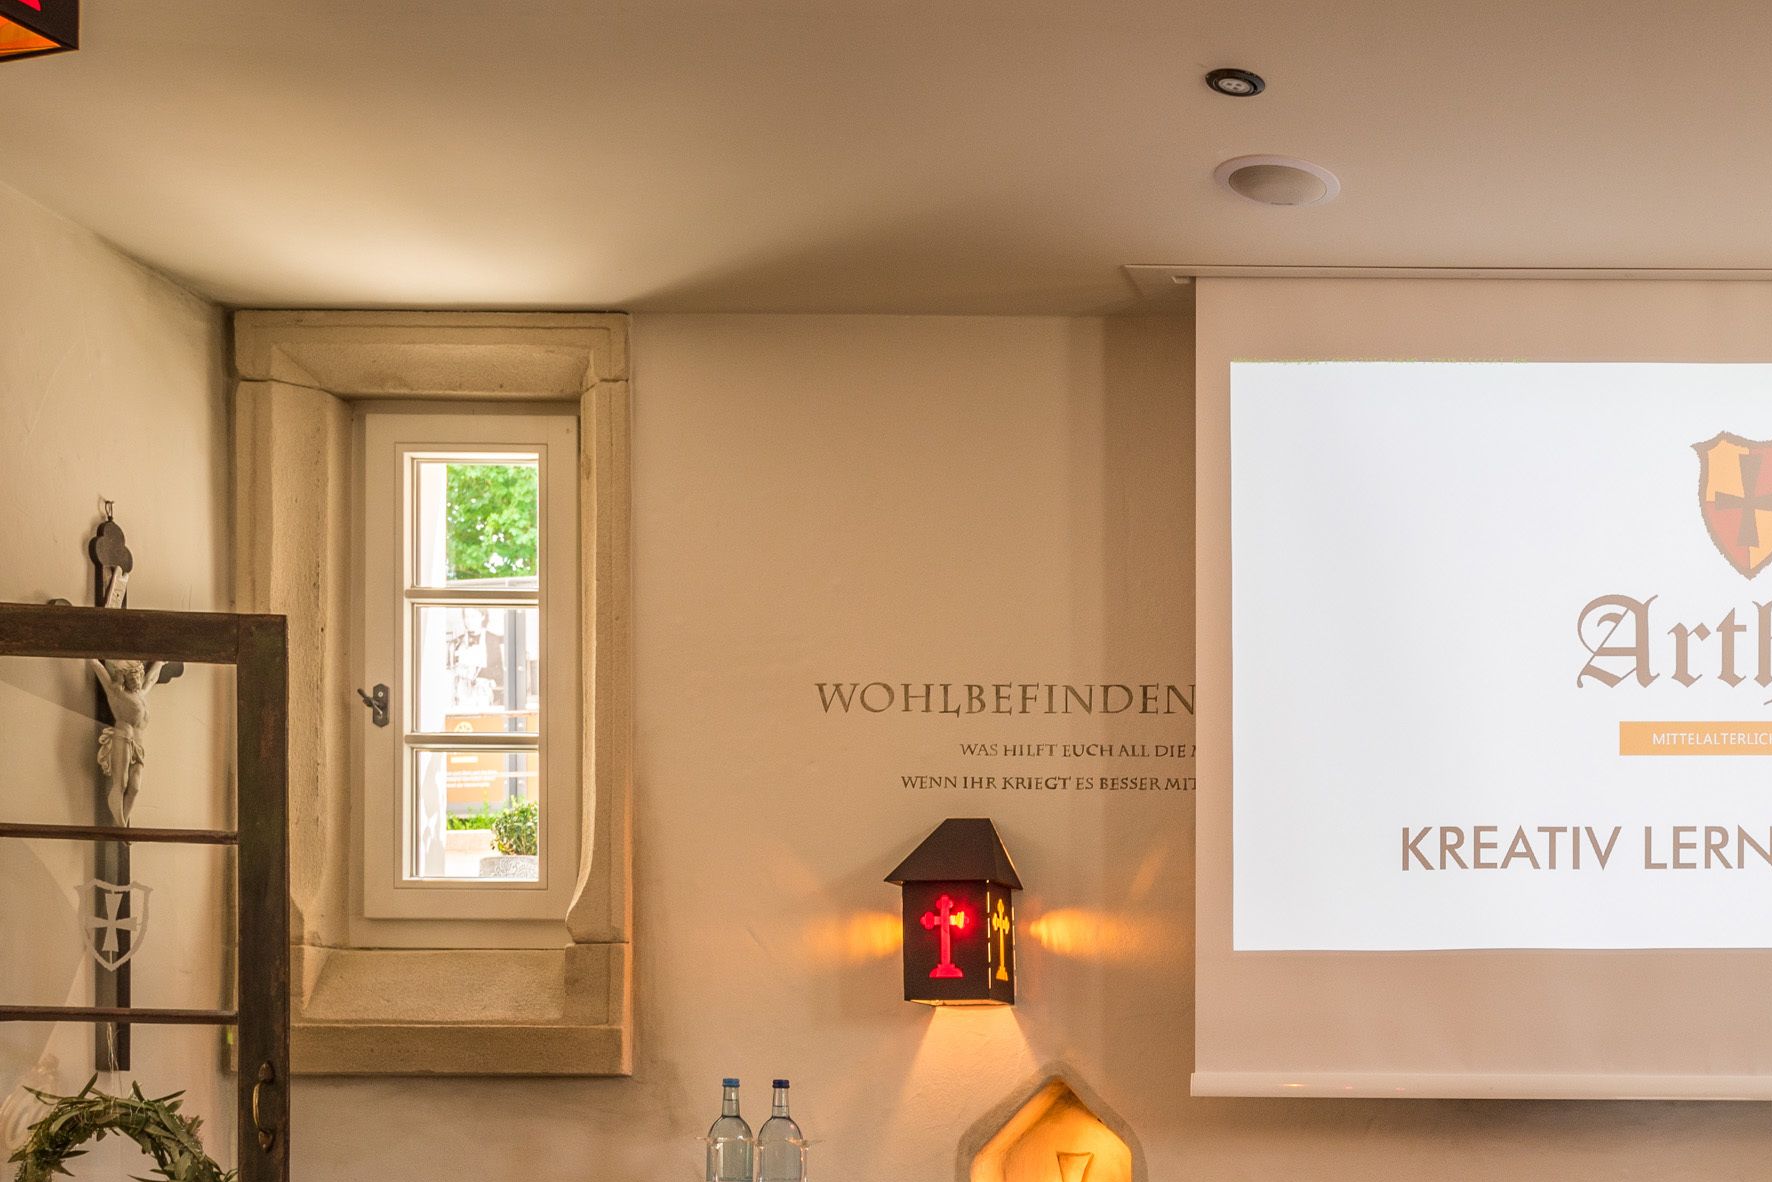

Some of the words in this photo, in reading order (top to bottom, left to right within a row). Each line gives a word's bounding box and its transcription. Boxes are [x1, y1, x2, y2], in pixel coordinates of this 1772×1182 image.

[815, 682, 1196, 719] WOHLBEFINDEN
[960, 744, 998, 758] WAS
[1004, 744, 1057, 758] HILFT
[1062, 744, 1113, 758] EUCH
[1118, 745, 1149, 758] ALL
[1156, 745, 1187, 759] DIE
[901, 776, 957, 790] WENN
[963, 777, 997, 790] IHR
[1076, 777, 1094, 790] ES
[1100, 777, 1161, 791] BESSER
[1402, 826, 1622, 872] KREATIV
